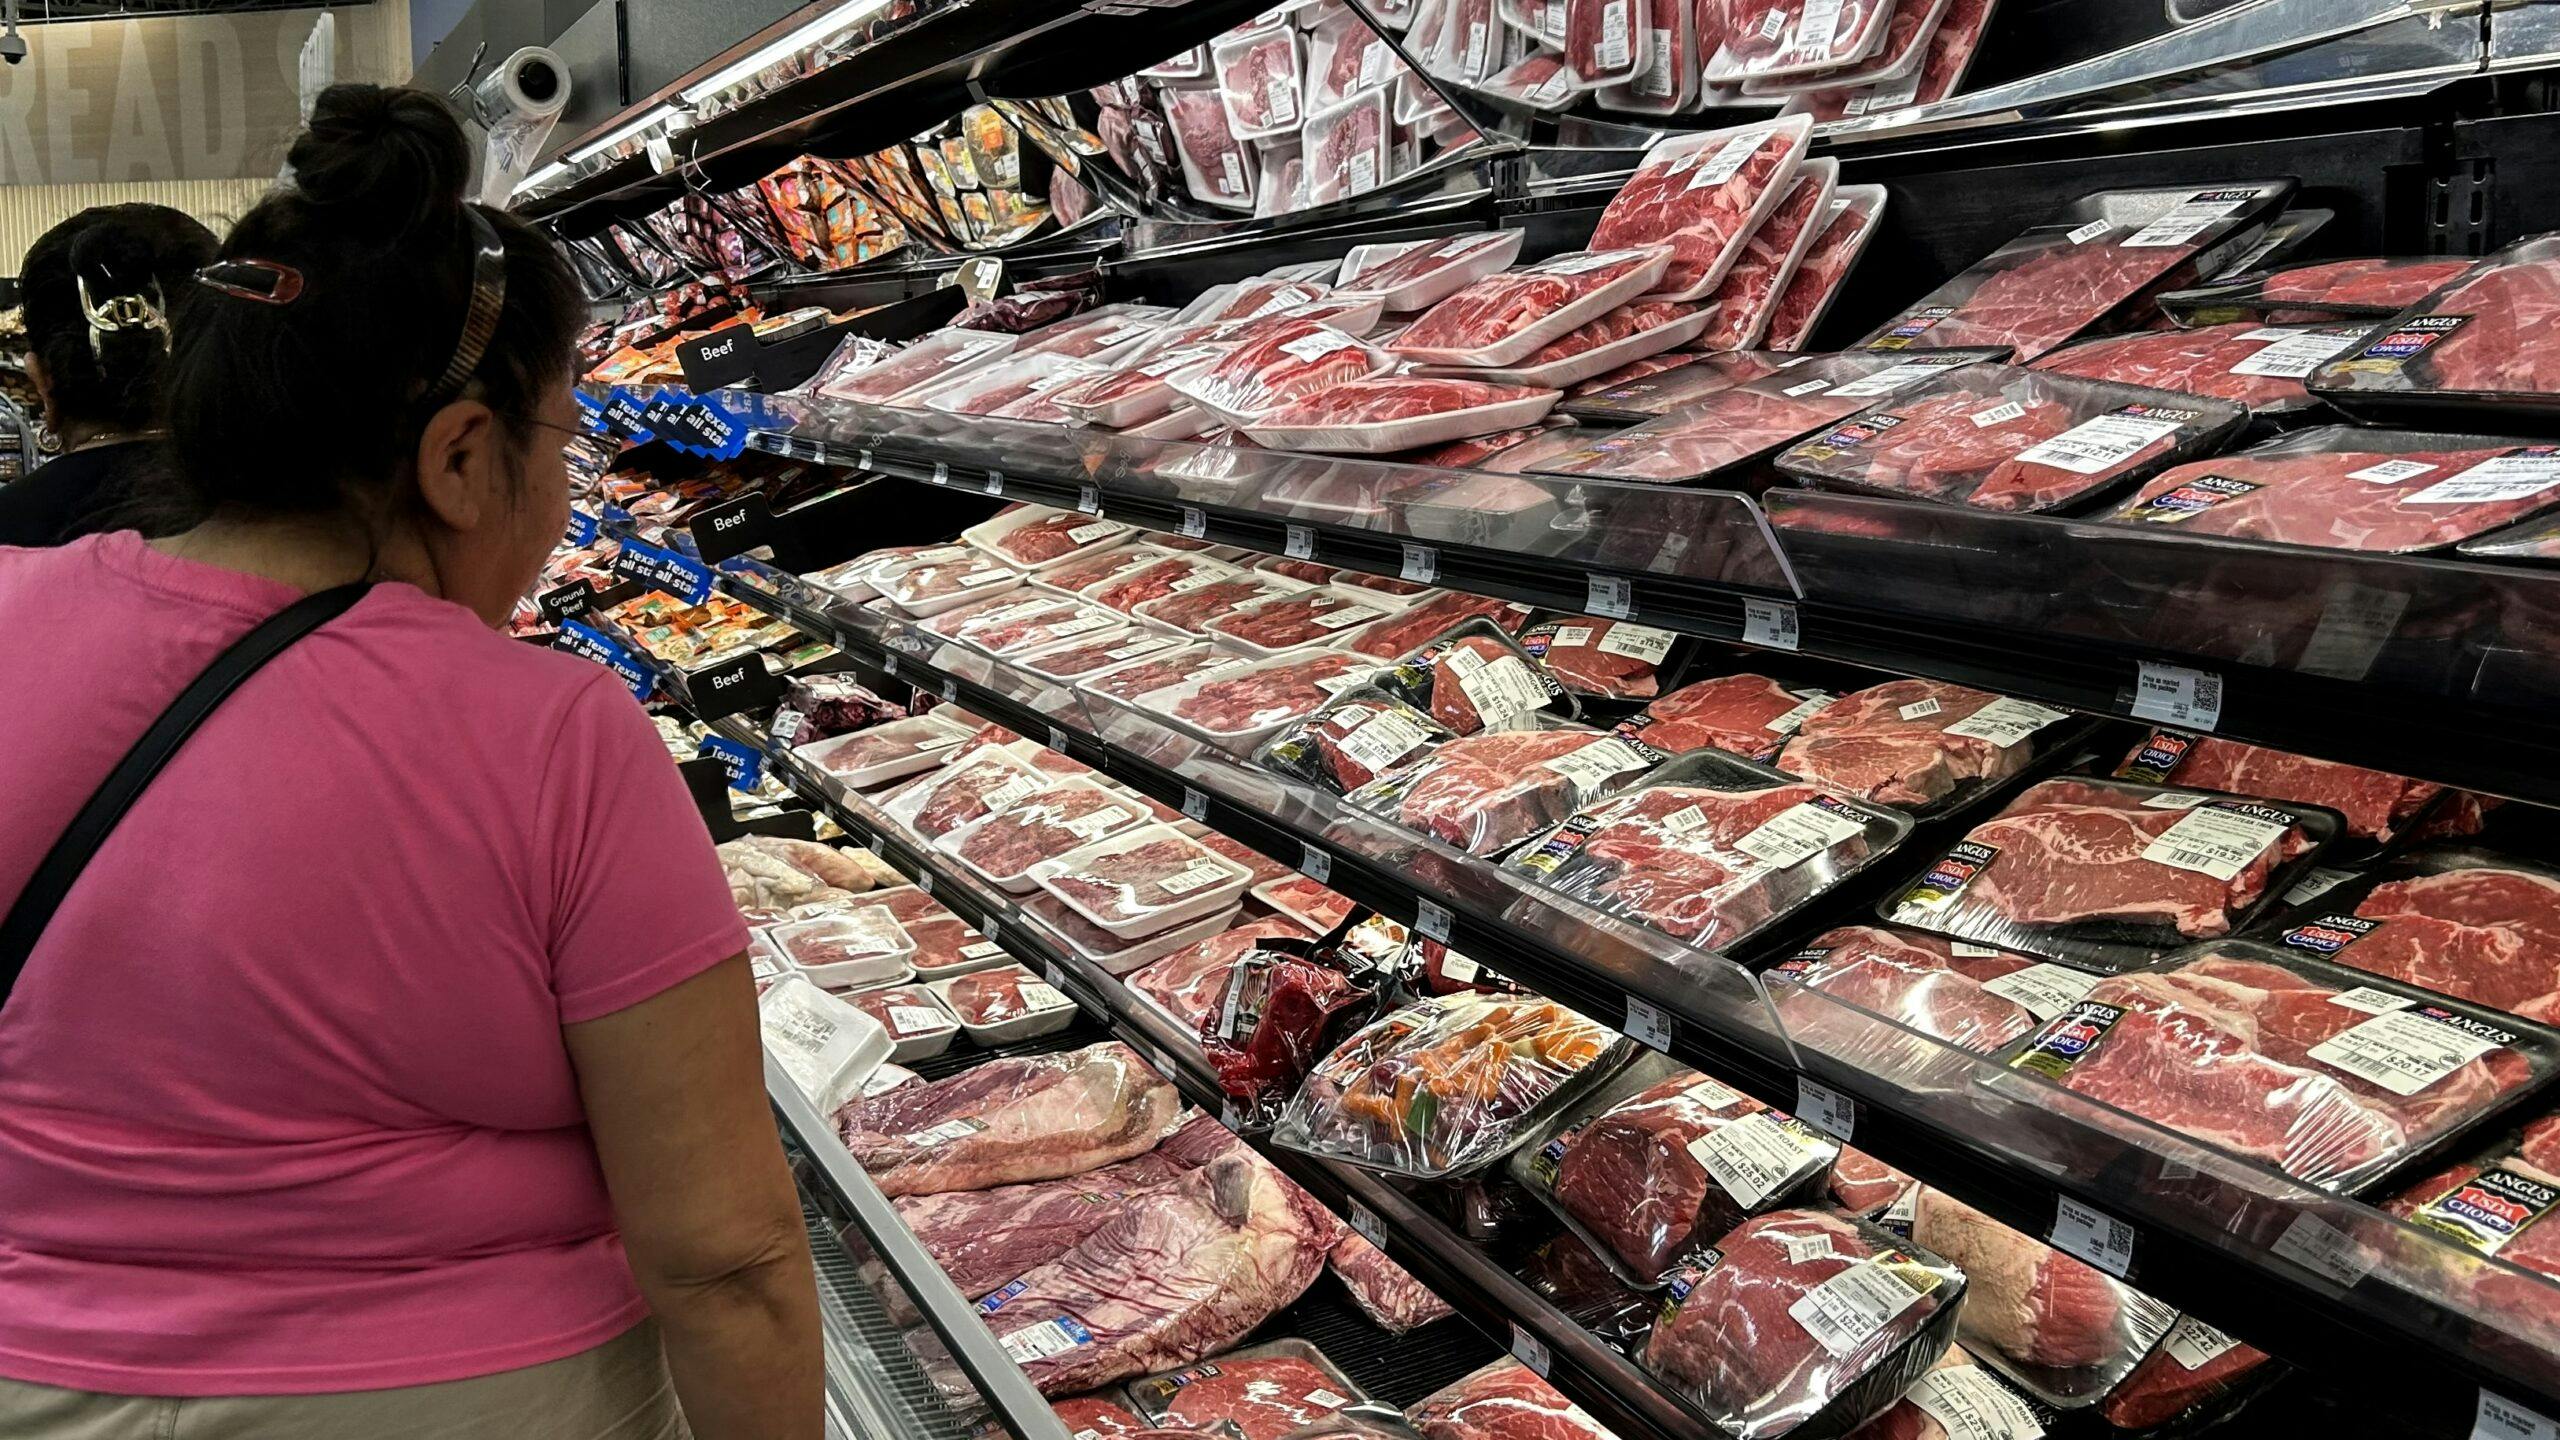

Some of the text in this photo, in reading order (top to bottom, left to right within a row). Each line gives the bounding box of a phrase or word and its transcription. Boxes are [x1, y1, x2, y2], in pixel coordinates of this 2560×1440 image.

[2409, 317, 2462, 328] ANGUS
[700, 338, 735, 361] Beef
[623, 417, 646, 435] star
[686, 413, 728, 449] all star
[700, 404, 733, 437] Texas
[713, 509, 748, 532] Beef
[619, 559, 636, 571] all
[666, 559, 700, 584] Texas
[655, 569, 698, 596] all star
[550, 586, 586, 608] Ground
[561, 599, 584, 617] Beef
[612, 660, 642, 682] Texas
[712, 668, 745, 690] Beef
[1492, 695, 1511, 718] $15.24
[1627, 739, 1662, 763] ANGUS
[2143, 748, 2176, 762] CHOICE
[2154, 740, 2178, 752] USDA
[1831, 803, 1874, 824] ANGUS
[2235, 803, 2295, 824] ANGUS
[1956, 843, 1992, 860] ANGUS
[2205, 847, 2243, 863] $19.37
[1928, 872, 1963, 886] CHOICE
[1940, 863, 1966, 876] USDA
[2320, 915, 2374, 930] ANGUS
[2292, 934, 2341, 948] CHOICE
[2307, 929, 2343, 942] USDA
[2443, 1015, 2518, 1044] ANGUS
[2386, 1055, 2431, 1076] $20.17
[1755, 1118, 1779, 1134] RUMP
[1778, 1133, 1805, 1155] ROAST
[1737, 1162, 1765, 1190] $25.02
[2486, 1172, 2556, 1201] ANGUS
[2448, 1198, 2512, 1230] CHOICE
[2467, 1192, 2515, 1218] USDA
[1839, 1314, 1866, 1338] $23.54
[2182, 1324, 2214, 1352] $22.42
[2016, 1405, 2036, 1429] ROAST
